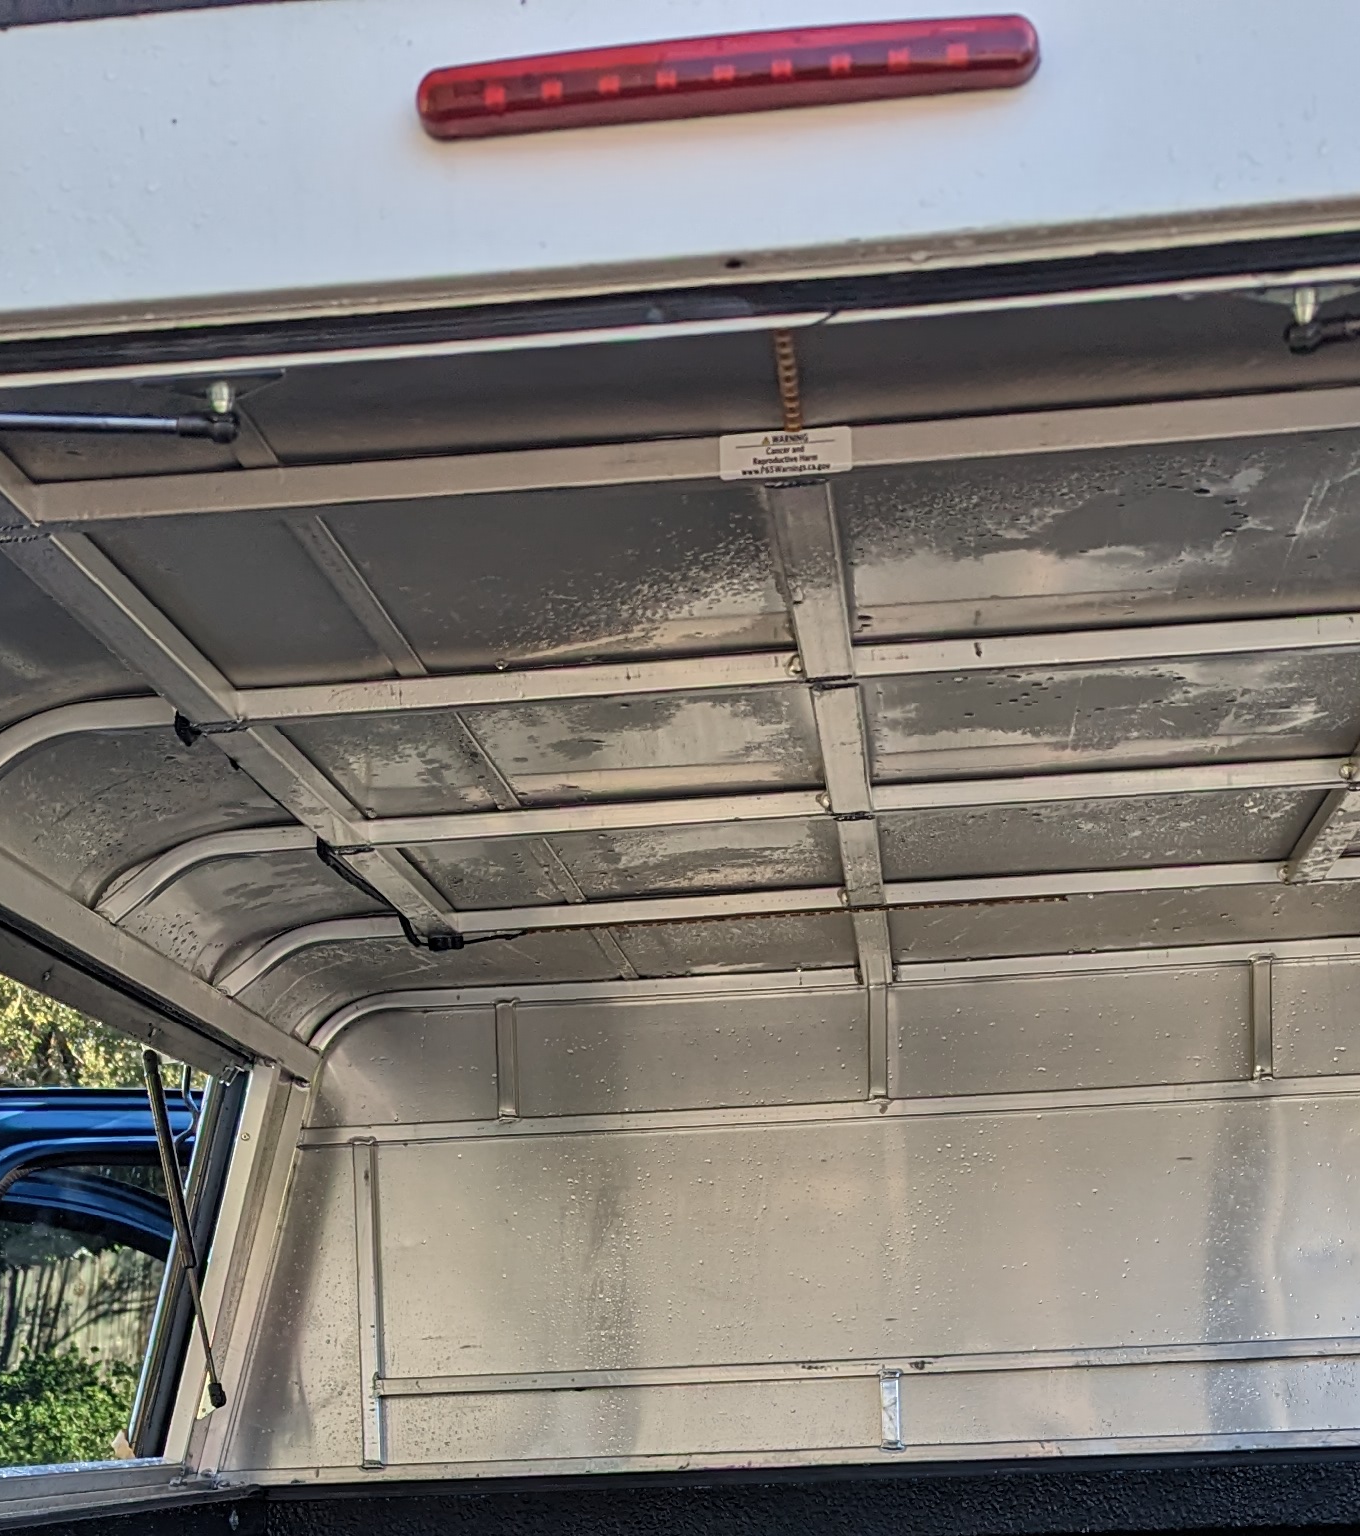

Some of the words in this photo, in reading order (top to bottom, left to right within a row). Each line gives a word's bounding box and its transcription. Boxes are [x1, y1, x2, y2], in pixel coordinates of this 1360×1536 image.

[772, 434, 809, 443] WARNING
[766, 446, 790, 455] Cancer
[791, 445, 805, 454] and
[753, 455, 798, 465] Reproductive
[799, 454, 818, 463] Harm
[741, 464, 831, 476] www.P65Warnings.ca.gov
